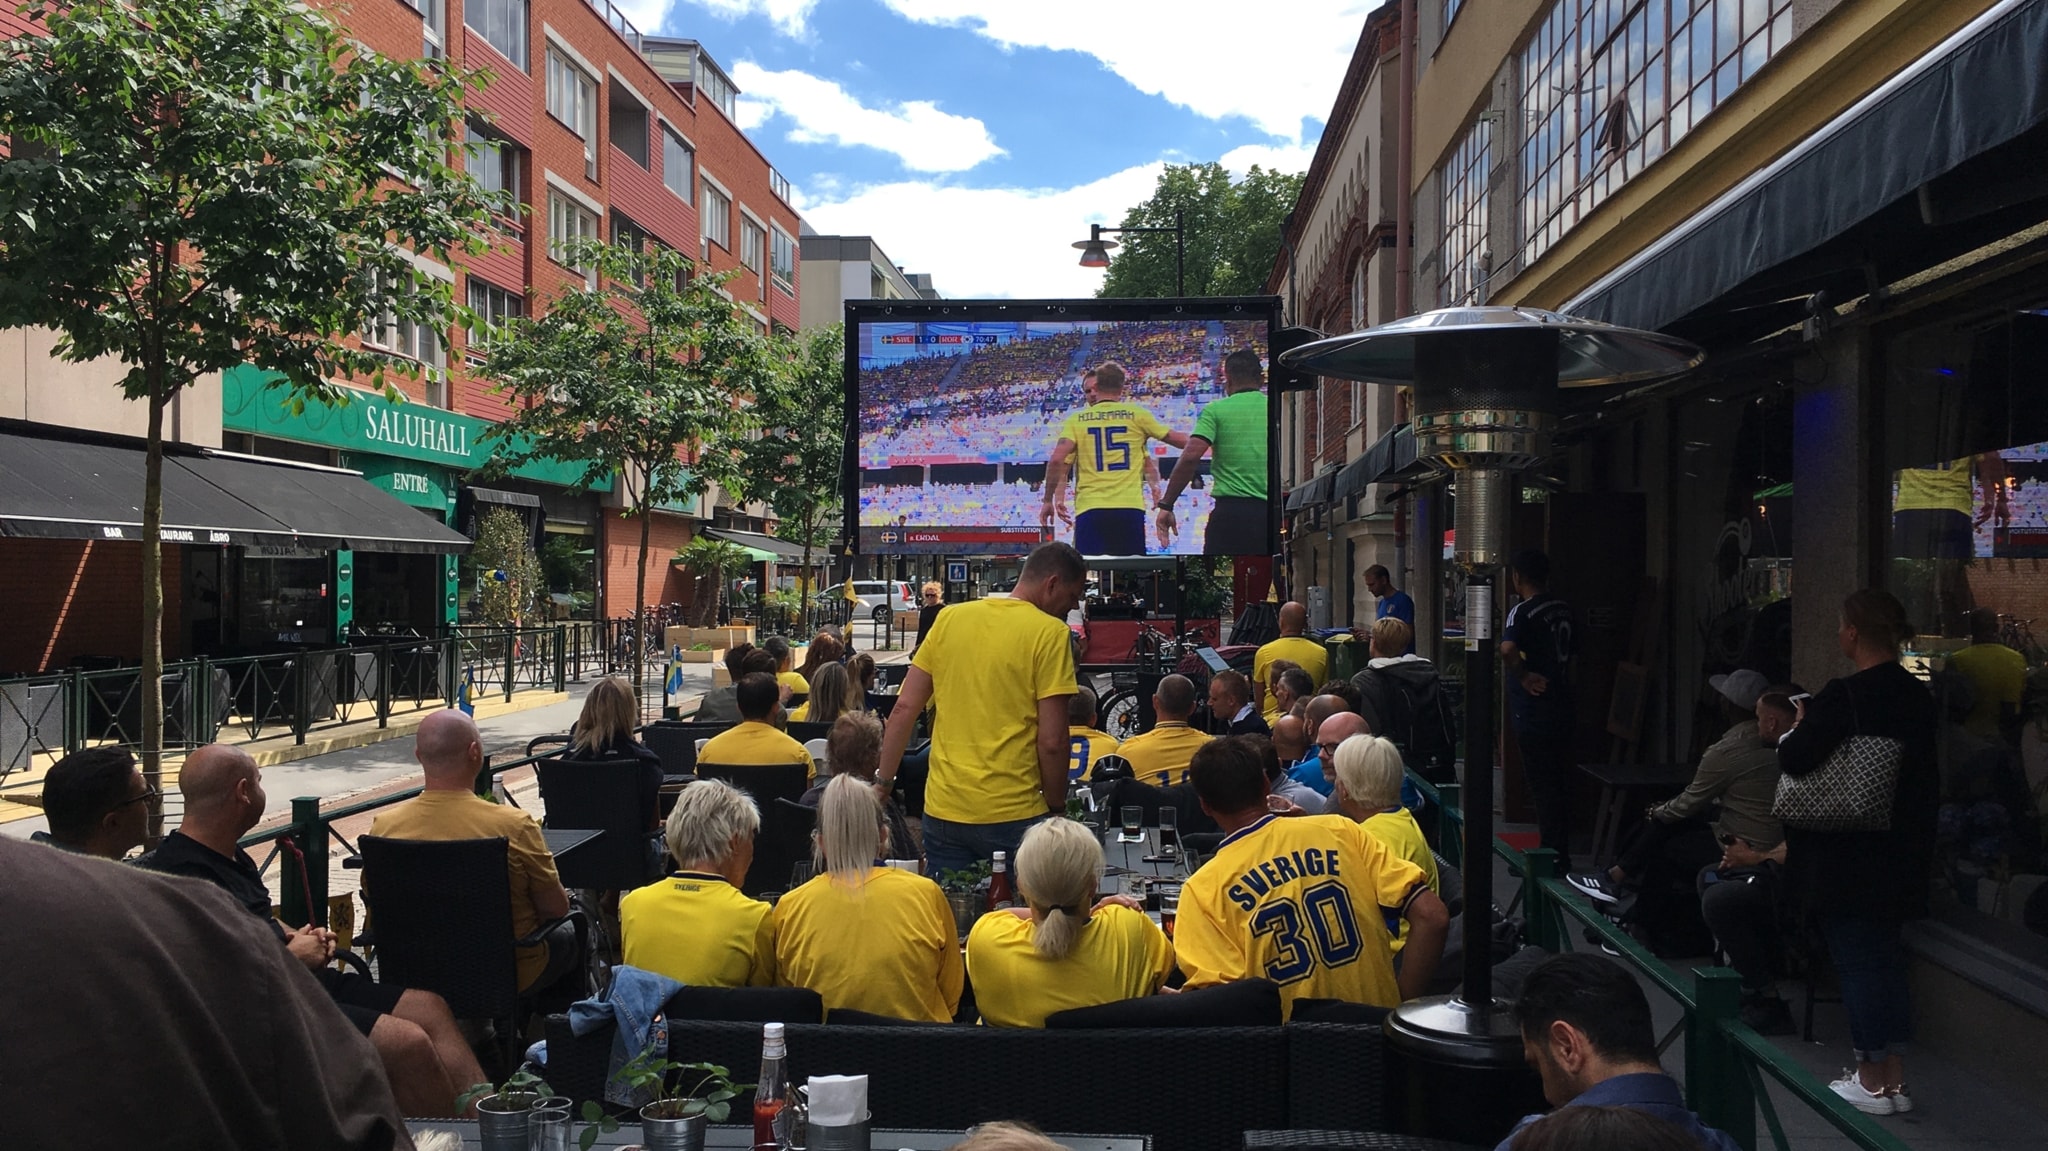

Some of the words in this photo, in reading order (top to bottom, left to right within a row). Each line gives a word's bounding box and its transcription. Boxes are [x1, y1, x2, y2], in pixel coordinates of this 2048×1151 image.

[366, 405, 471, 456] SALUHALL
[1087, 426, 1130, 472] 15
[393, 472, 429, 493] ENTRÉ
[103, 527, 124, 538] BAR
[210, 530, 230, 542] ÅBRO
[674, 883, 701, 892] SVERIGE
[1228, 848, 1340, 912] SVERIGE
[1249, 879, 1364, 987] 30
